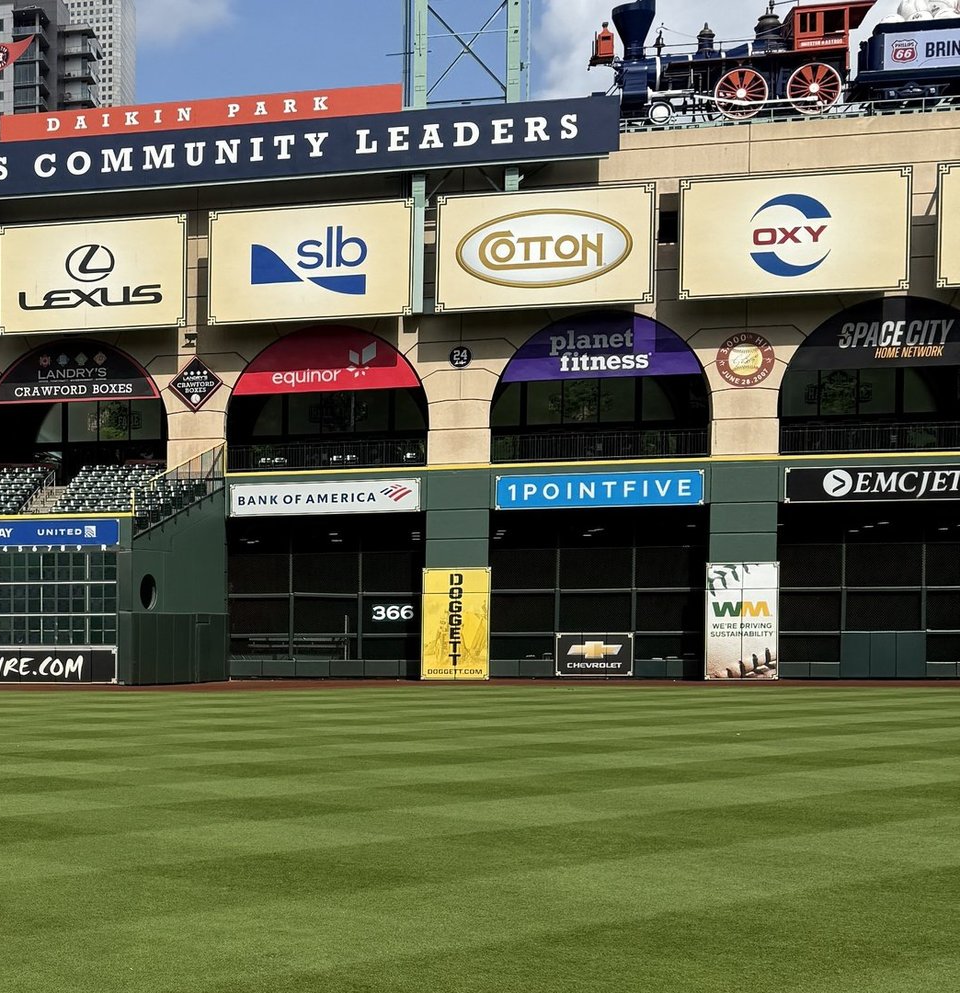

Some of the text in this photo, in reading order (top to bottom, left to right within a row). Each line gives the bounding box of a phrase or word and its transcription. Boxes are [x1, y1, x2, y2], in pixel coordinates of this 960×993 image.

[895, 48, 912, 59] 66
[46, 96, 329, 132] DAIKIN PARK
[33, 131, 329, 179] COMMUNITY
[355, 113, 578, 155] LEADERS
[752, 224, 828, 246] OXY
[296, 225, 368, 270] slb
[478, 230, 604, 271] COTTON
[18, 283, 163, 311] LEXUS
[549, 327, 634, 356] planet
[755, 336, 772, 352] HIT
[839, 319, 955, 349] SPACE CITY
[453, 349, 468, 360] 24
[559, 351, 650, 372] fitness
[874, 345, 945, 359] HOME NETWORK
[38, 367, 107, 380] LANDRY'S
[271, 368, 342, 388] equinor
[722, 370, 740, 384] JUNE
[14, 383, 133, 397] CRAWFORD BOXES
[238, 492, 377, 506] BANK OF AMERICA
[507, 479, 692, 501] 1POINTFIVE
[37, 528, 82, 536] UNITED
[372, 605, 414, 620] 366
[712, 601, 770, 617] WM
[448, 573, 463, 666] DOGGETT
